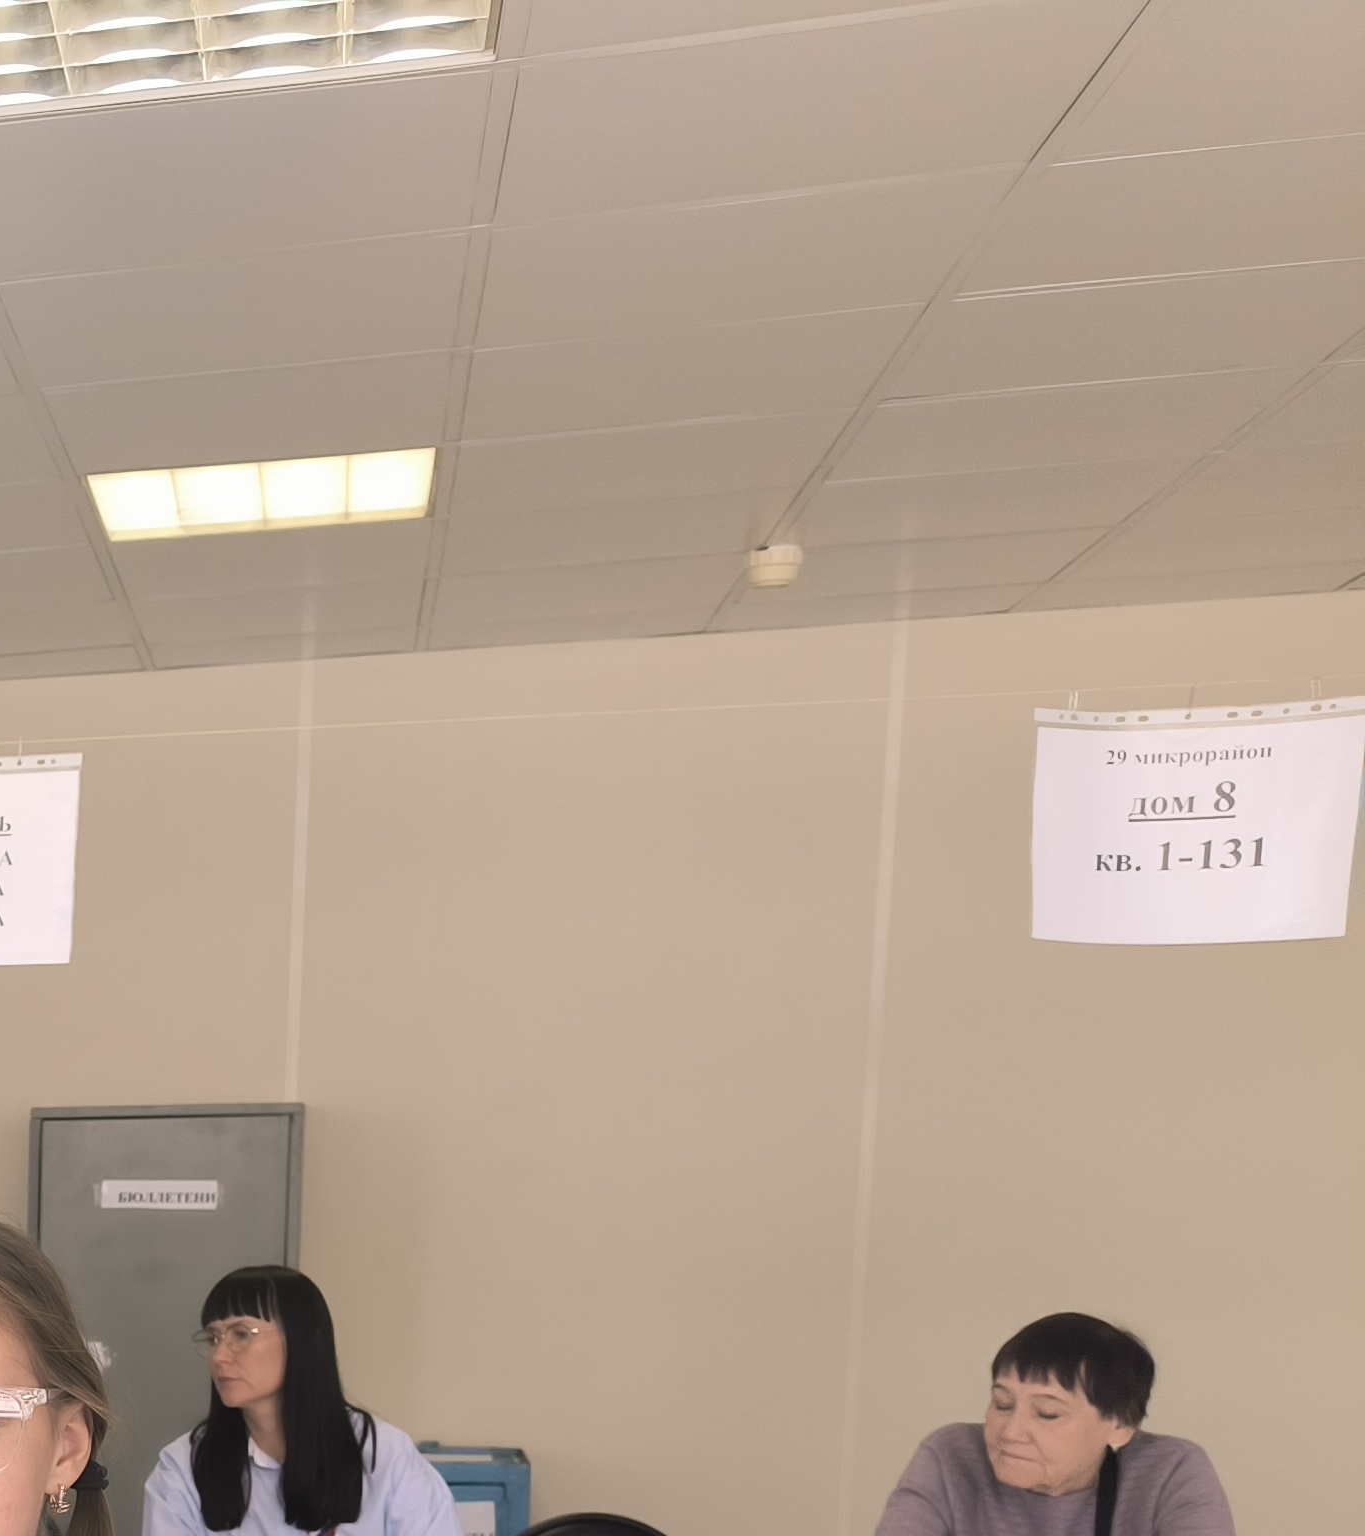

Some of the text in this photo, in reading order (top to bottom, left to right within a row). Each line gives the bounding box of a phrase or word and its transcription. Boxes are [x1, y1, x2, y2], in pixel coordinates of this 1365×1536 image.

[1105, 744, 1273, 767] 29 микрорайон
[1128, 780, 1237, 819] дом 8
[1095, 836, 1267, 873] кв. 1-131
[117, 1191, 217, 1205] БЮЛЛЕТЕНИ
